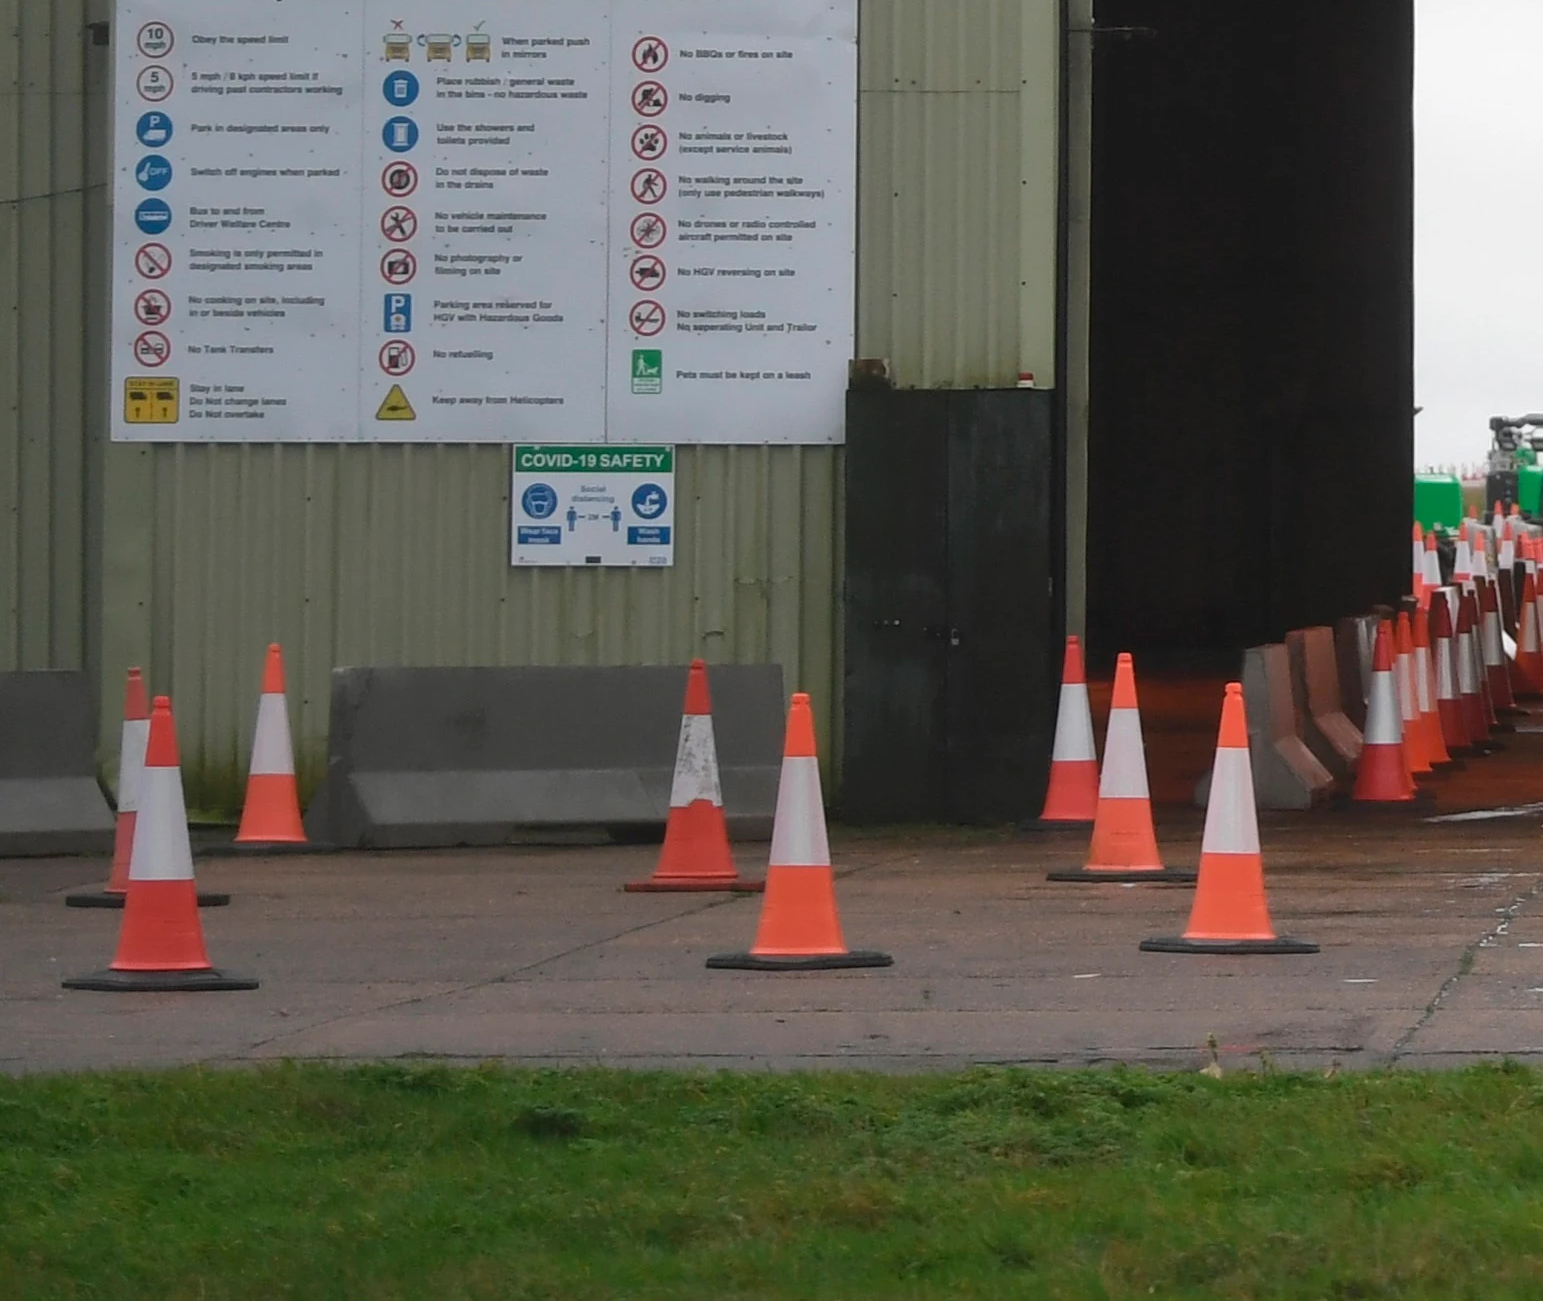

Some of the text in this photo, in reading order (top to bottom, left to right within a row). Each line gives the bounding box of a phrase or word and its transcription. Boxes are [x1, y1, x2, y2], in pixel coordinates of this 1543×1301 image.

[147, 28, 164, 40] 10
[191, 35, 288, 45] Obey the speed limit
[502, 37, 590, 47] When parked push
[501, 50, 511, 58] in
[679, 50, 693, 59] No
[696, 50, 723, 59] BBQs
[738, 50, 758, 59] fires
[776, 50, 793, 59] site
[150, 72, 159, 82] 5
[226, 86, 246, 95] past
[679, 93, 692, 102] No
[149, 115, 160, 127] P
[190, 124, 212, 132] Park
[214, 124, 224, 132] in
[309, 124, 329, 134] only
[436, 124, 455, 132] Use
[457, 124, 472, 132] the
[517, 124, 535, 132] and
[679, 132, 692, 141] No
[733, 133, 744, 141] or
[191, 168, 222, 176] Switch
[224, 168, 237, 176] off
[280, 168, 305, 176] when
[307, 168, 340, 178] parked
[678, 176, 692, 184] No
[733, 176, 766, 184] around
[769, 176, 783, 184] the
[786, 176, 803, 184] site
[434, 181, 494, 189] in the drains
[678, 189, 702, 198] (only
[190, 207, 265, 215] Bus to and from
[435, 212, 449, 221] No
[189, 220, 218, 228] Driver
[259, 220, 290, 228] Centre
[678, 220, 692, 229] No
[693, 220, 727, 229] drones
[742, 220, 766, 229] radio
[435, 225, 445, 234] to
[447, 225, 459, 234] be
[497, 225, 513, 234] out
[434, 254, 448, 262] No
[484, 267, 500, 275] site
[677, 268, 691, 276] No
[693, 268, 715, 276] HGV
[779, 268, 795, 276] site
[188, 296, 202, 305] No
[259, 296, 279, 306] site,
[391, 296, 404, 312] P
[539, 300, 552, 308] for
[433, 313, 455, 322] HGV
[457, 313, 477, 322] with
[533, 313, 563, 322] Goods
[676, 310, 691, 318] No
[740, 310, 765, 318] loads
[188, 345, 201, 354] No
[204, 345, 227, 354] Tank
[433, 350, 446, 358] No
[676, 371, 697, 379] Pets
[699, 371, 723, 379] must
[725, 371, 737, 379] be
[740, 371, 760, 380] kept
[785, 371, 811, 379] leash
[190, 384, 244, 394] Stay in lane
[432, 396, 456, 405] Keep
[486, 396, 507, 404] from
[189, 410, 202, 418] Do
[205, 410, 222, 418] Not
[521, 454, 663, 467] COVID-19 SAFETY
